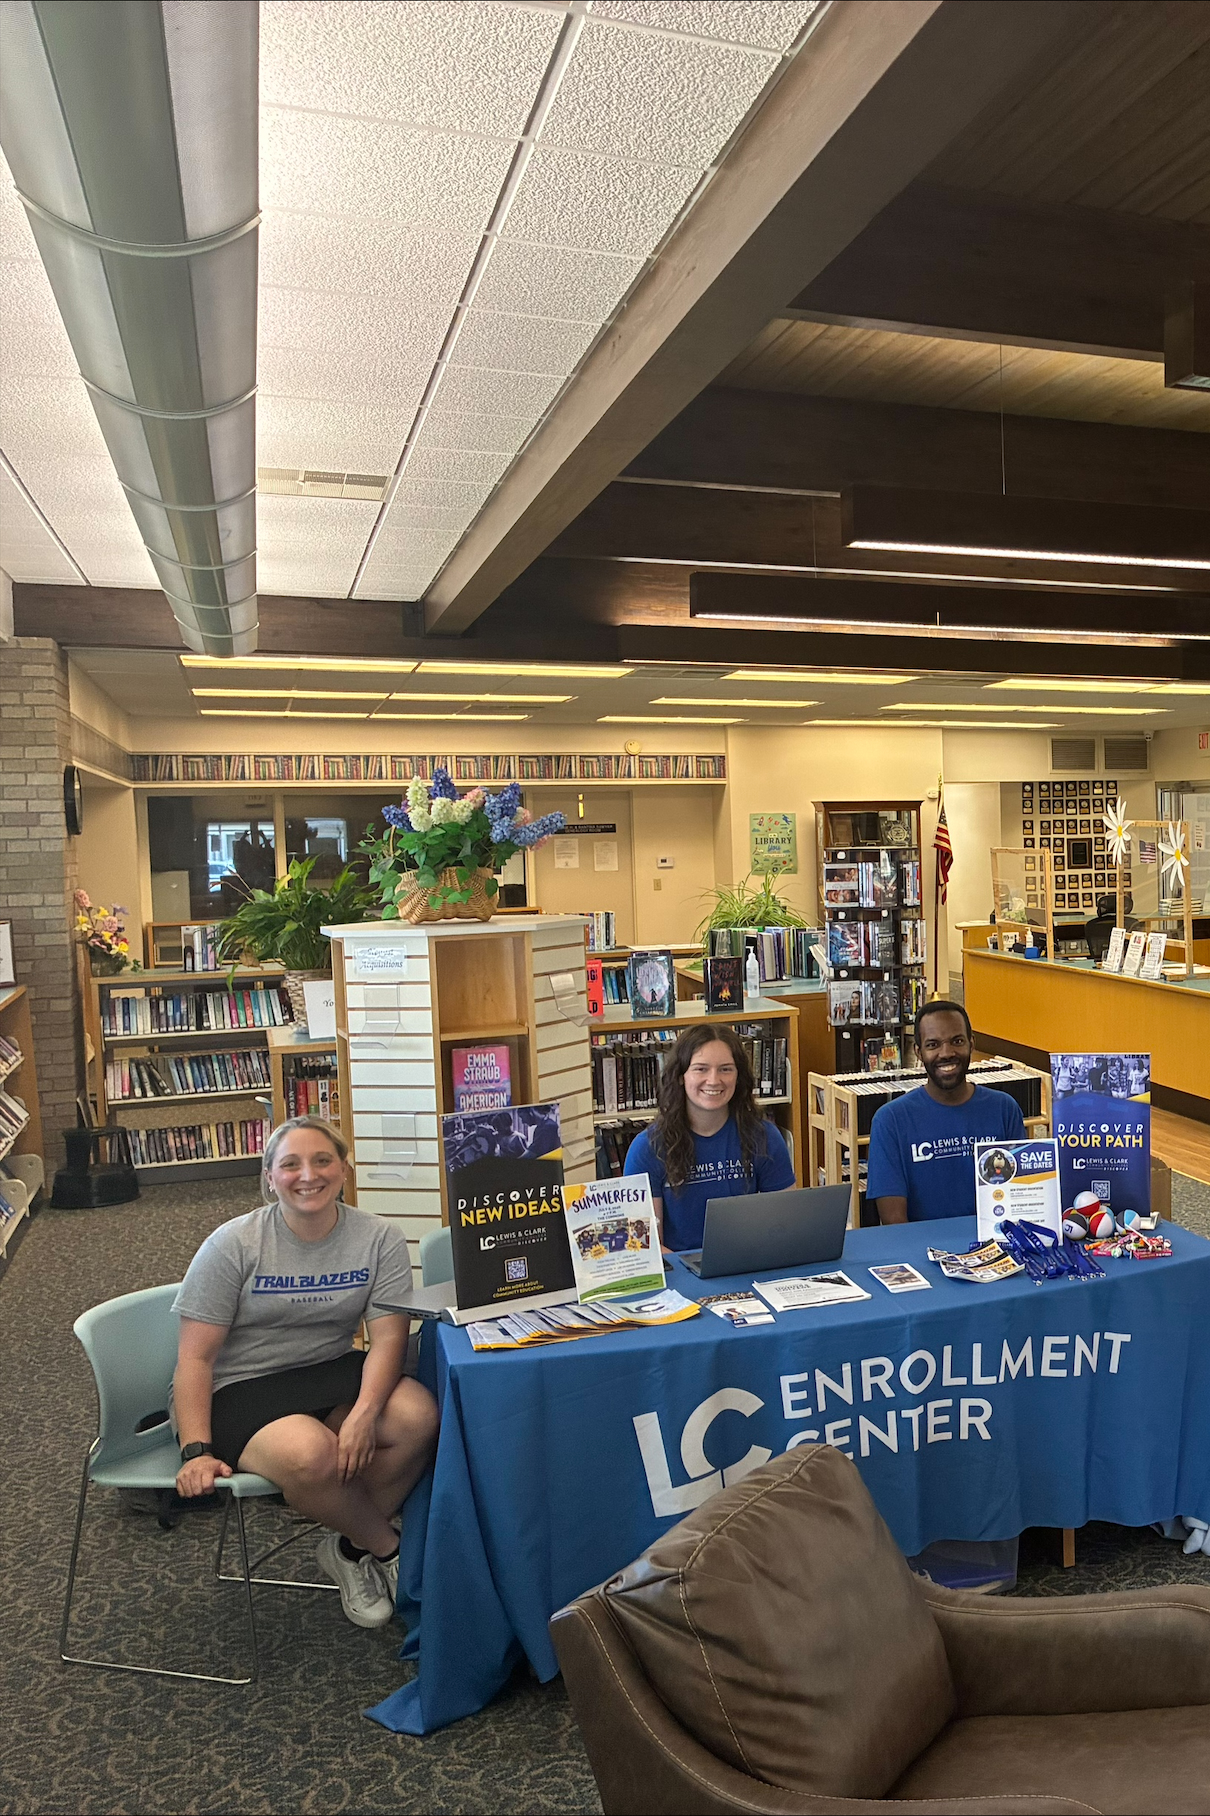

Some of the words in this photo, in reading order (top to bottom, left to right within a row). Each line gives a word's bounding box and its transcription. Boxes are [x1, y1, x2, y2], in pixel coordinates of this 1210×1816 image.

[755, 837, 792, 845] LIBRARY
[467, 1053, 496, 1068] EMMA
[464, 1066, 501, 1082] STRAUB
[460, 1092, 508, 1109] AMERICAN
[1058, 1123, 1143, 1133] DISCOVER
[1058, 1134, 1102, 1148] YOUR
[1105, 1134, 1143, 1148] PATH
[911, 1141, 934, 1162] LC
[933, 1137, 960, 1149] LEWIS
[961, 1136, 968, 1145] &
[933, 1145, 971, 1155] COMMUNITY
[1020, 1151, 1053, 1163] SAVE
[1073, 1158, 1086, 1170] LC
[717, 1161, 724, 1170] &
[1020, 1162, 1032, 1170] THE
[1033, 1161, 1053, 1169] DATES
[458, 1185, 561, 1210] DISCOVER
[572, 1188, 647, 1214] SUMMERFEST
[461, 1205, 504, 1227] NEW
[508, 1197, 562, 1220] IDEAS
[480, 1236, 496, 1251] LC
[496, 1231, 517, 1241] LEWIS
[517, 1230, 523, 1238] &
[523, 1226, 547, 1237] CLARK
[254, 1267, 370, 1289] TRAILBLAZERS
[291, 1296, 334, 1304] BASEBALL
[632, 1386, 773, 1518] LC
[779, 1331, 1132, 1420] ENROLLMENT
